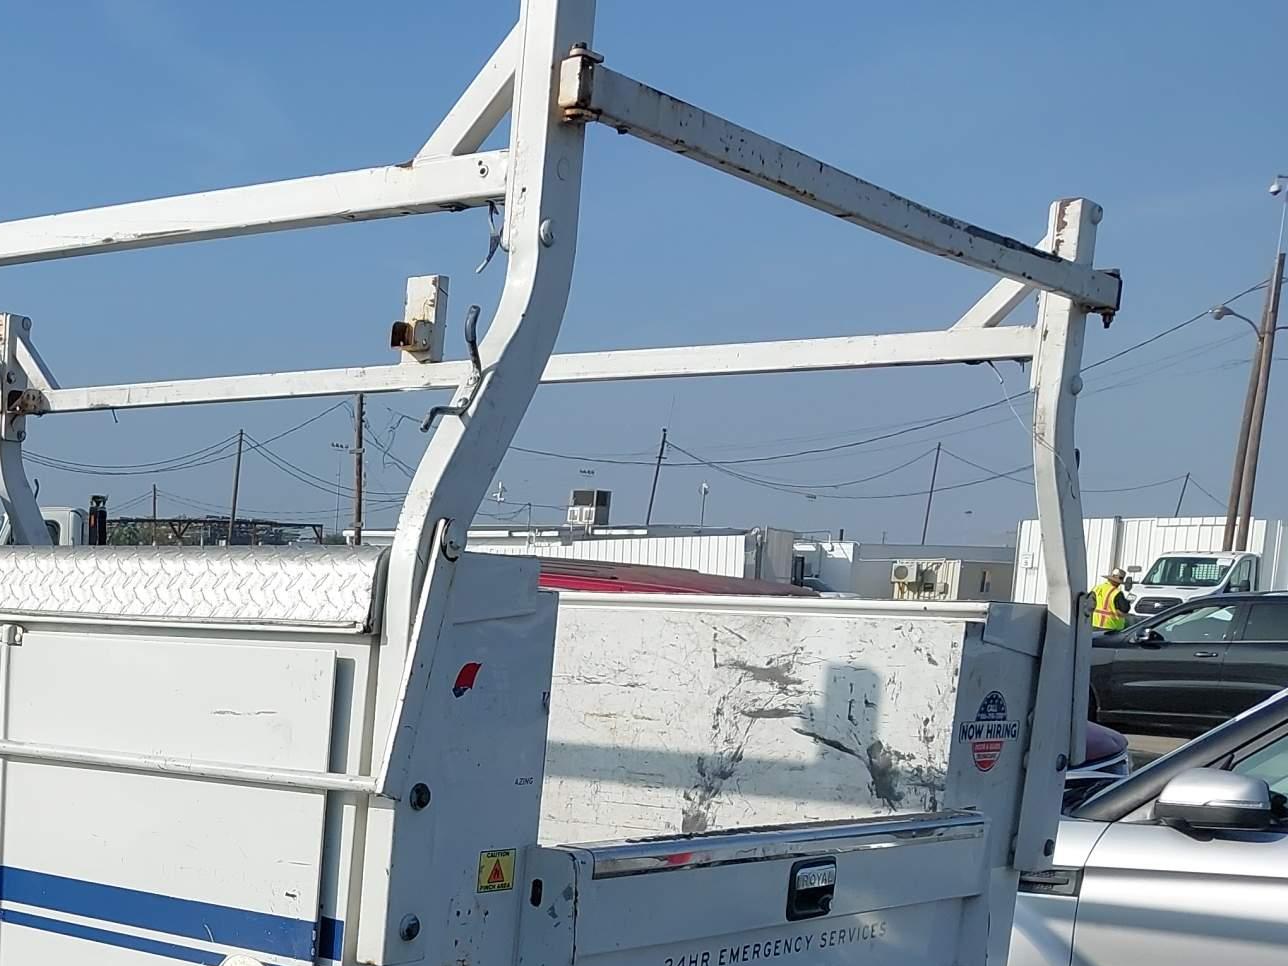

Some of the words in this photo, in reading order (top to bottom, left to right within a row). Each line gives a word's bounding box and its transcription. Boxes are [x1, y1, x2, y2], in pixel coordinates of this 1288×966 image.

[960, 724, 984, 741] NOW
[985, 722, 1017, 739] HIRING
[801, 870, 835, 889] ROYAL
[718, 934, 813, 966] EMERGENCY
[819, 920, 888, 949] SERVICES
